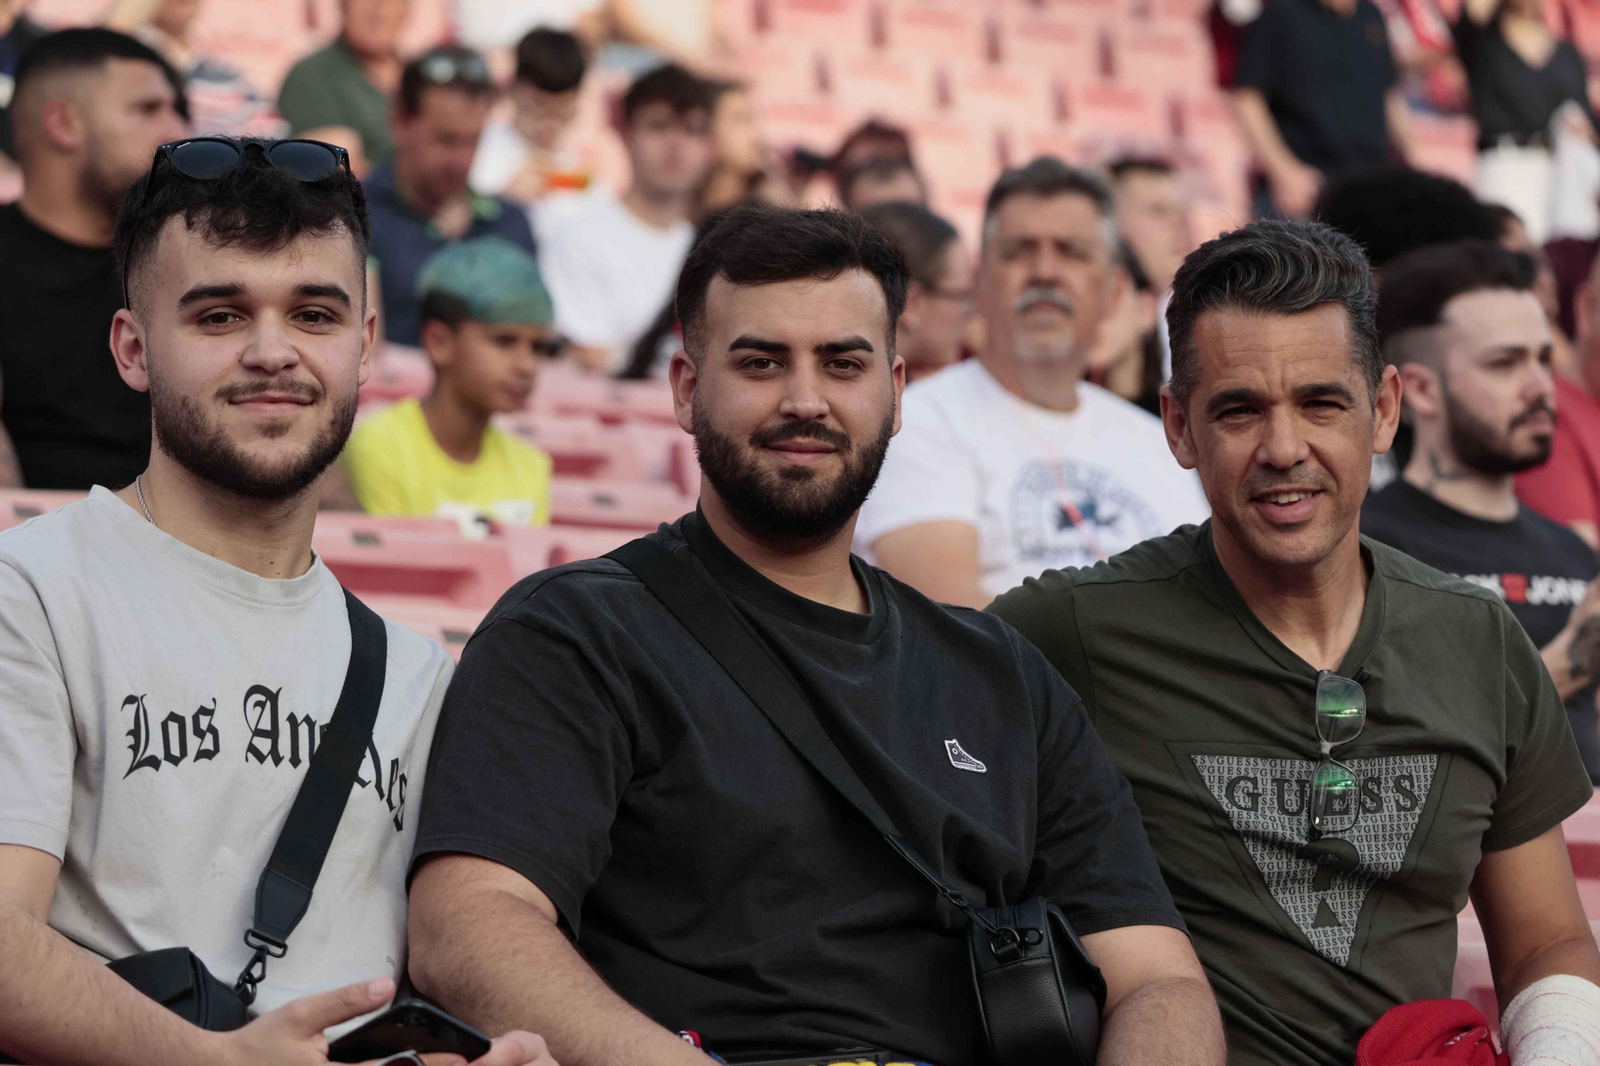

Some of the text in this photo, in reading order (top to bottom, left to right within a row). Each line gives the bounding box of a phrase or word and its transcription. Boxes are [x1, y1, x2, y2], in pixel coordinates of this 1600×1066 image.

[121, 684, 408, 832] Los Anles
[1216, 756, 1259, 767] GUESS
[1269, 759, 1312, 769] GUESS
[1369, 756, 1404, 767] GUESS
[1207, 765, 1250, 775] GUESS
[1260, 768, 1302, 778] GUESS
[1362, 766, 1397, 777] GUESS
[1406, 764, 1435, 774] GUES
[1224, 773, 1419, 817] GUESS
[1227, 811, 1260, 820] UESS
[1370, 812, 1408, 823] GUESS
[1363, 823, 1401, 834] GUESS
[1356, 833, 1394, 844] GUESS
[1358, 842, 1387, 853] UESS
[1267, 860, 1308, 871] GUESS
[1267, 869, 1298, 880] UESS
[1337, 882, 1370, 892] GUES
[1281, 890, 1368, 905] GUESS GUESS
[1284, 900, 1360, 914] UESS UESS
[1305, 928, 1344, 940] GUESS
